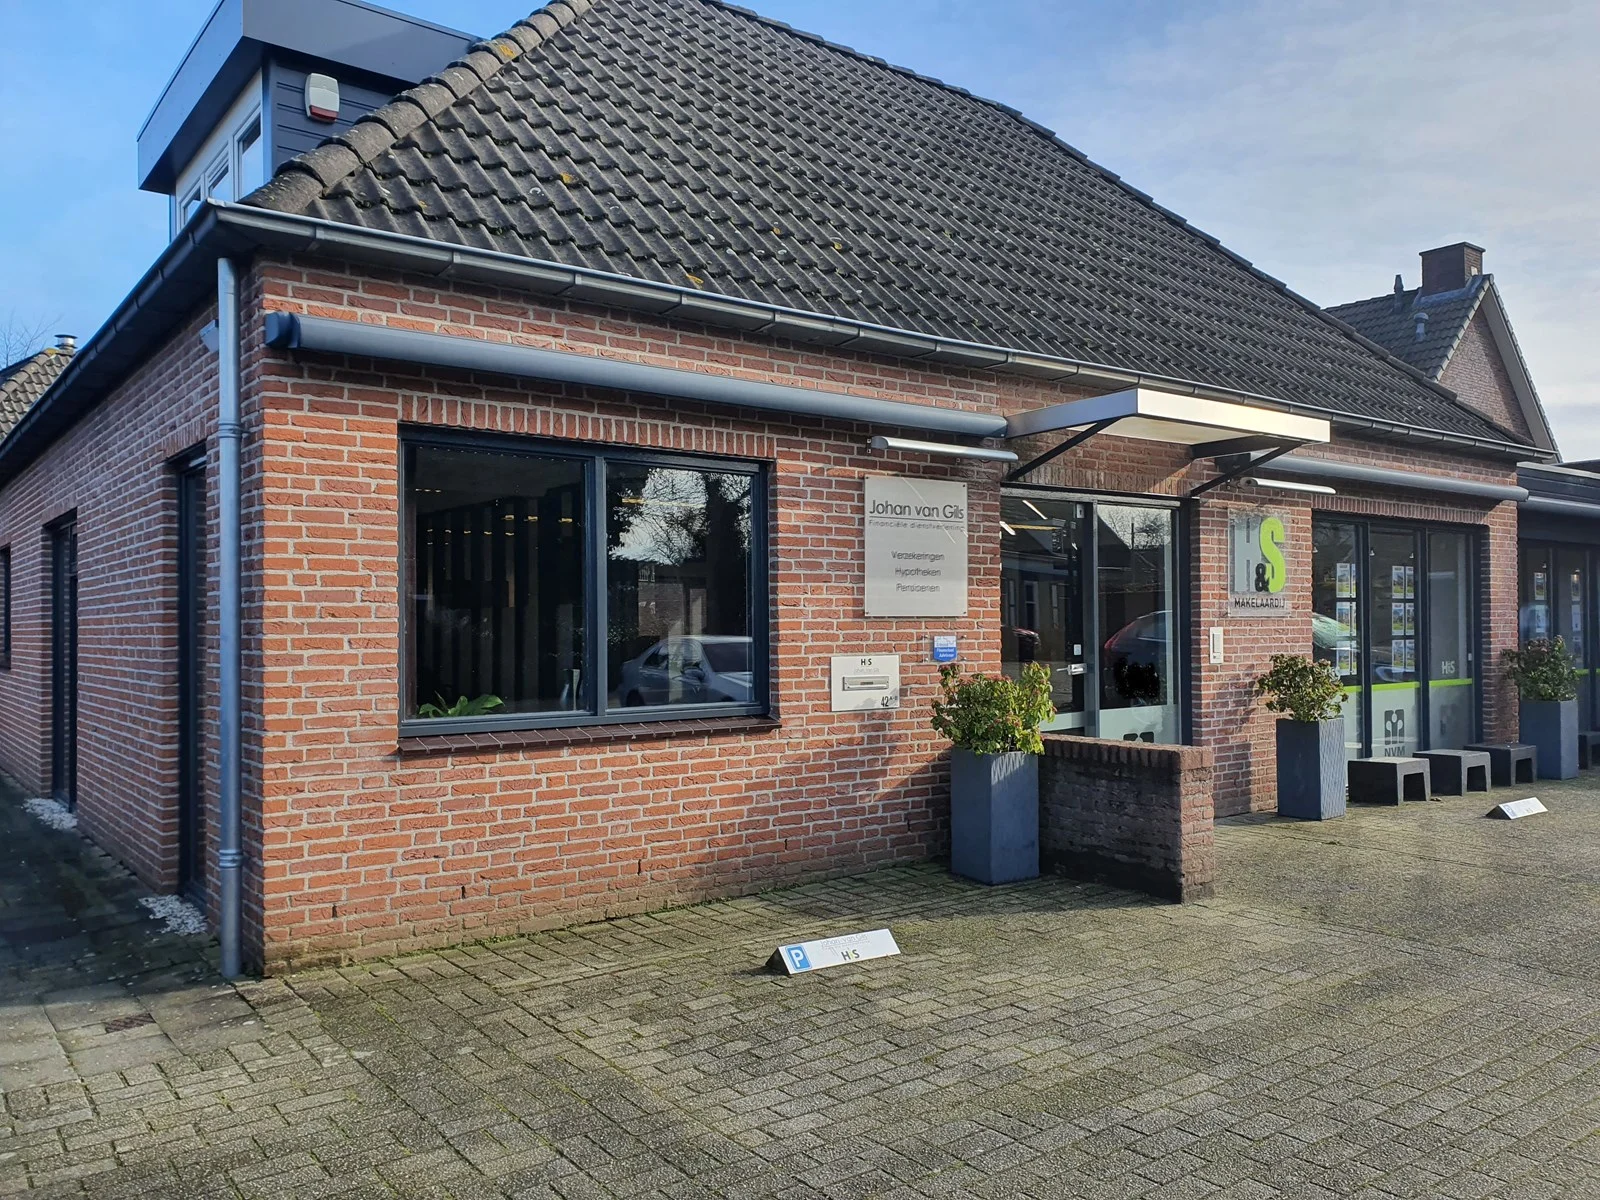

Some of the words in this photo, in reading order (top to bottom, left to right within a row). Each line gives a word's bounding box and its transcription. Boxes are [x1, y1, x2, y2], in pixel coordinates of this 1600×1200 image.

[869, 500, 911, 516] Johan
[915, 505, 939, 517] van
[943, 504, 964, 519] Gils
[891, 551, 945, 563] Verzekeringen
[1233, 516, 1286, 593] H&S
[895, 567, 941, 578] Hypotheken
[1234, 597, 1285, 609] MAKELAARDIJ
